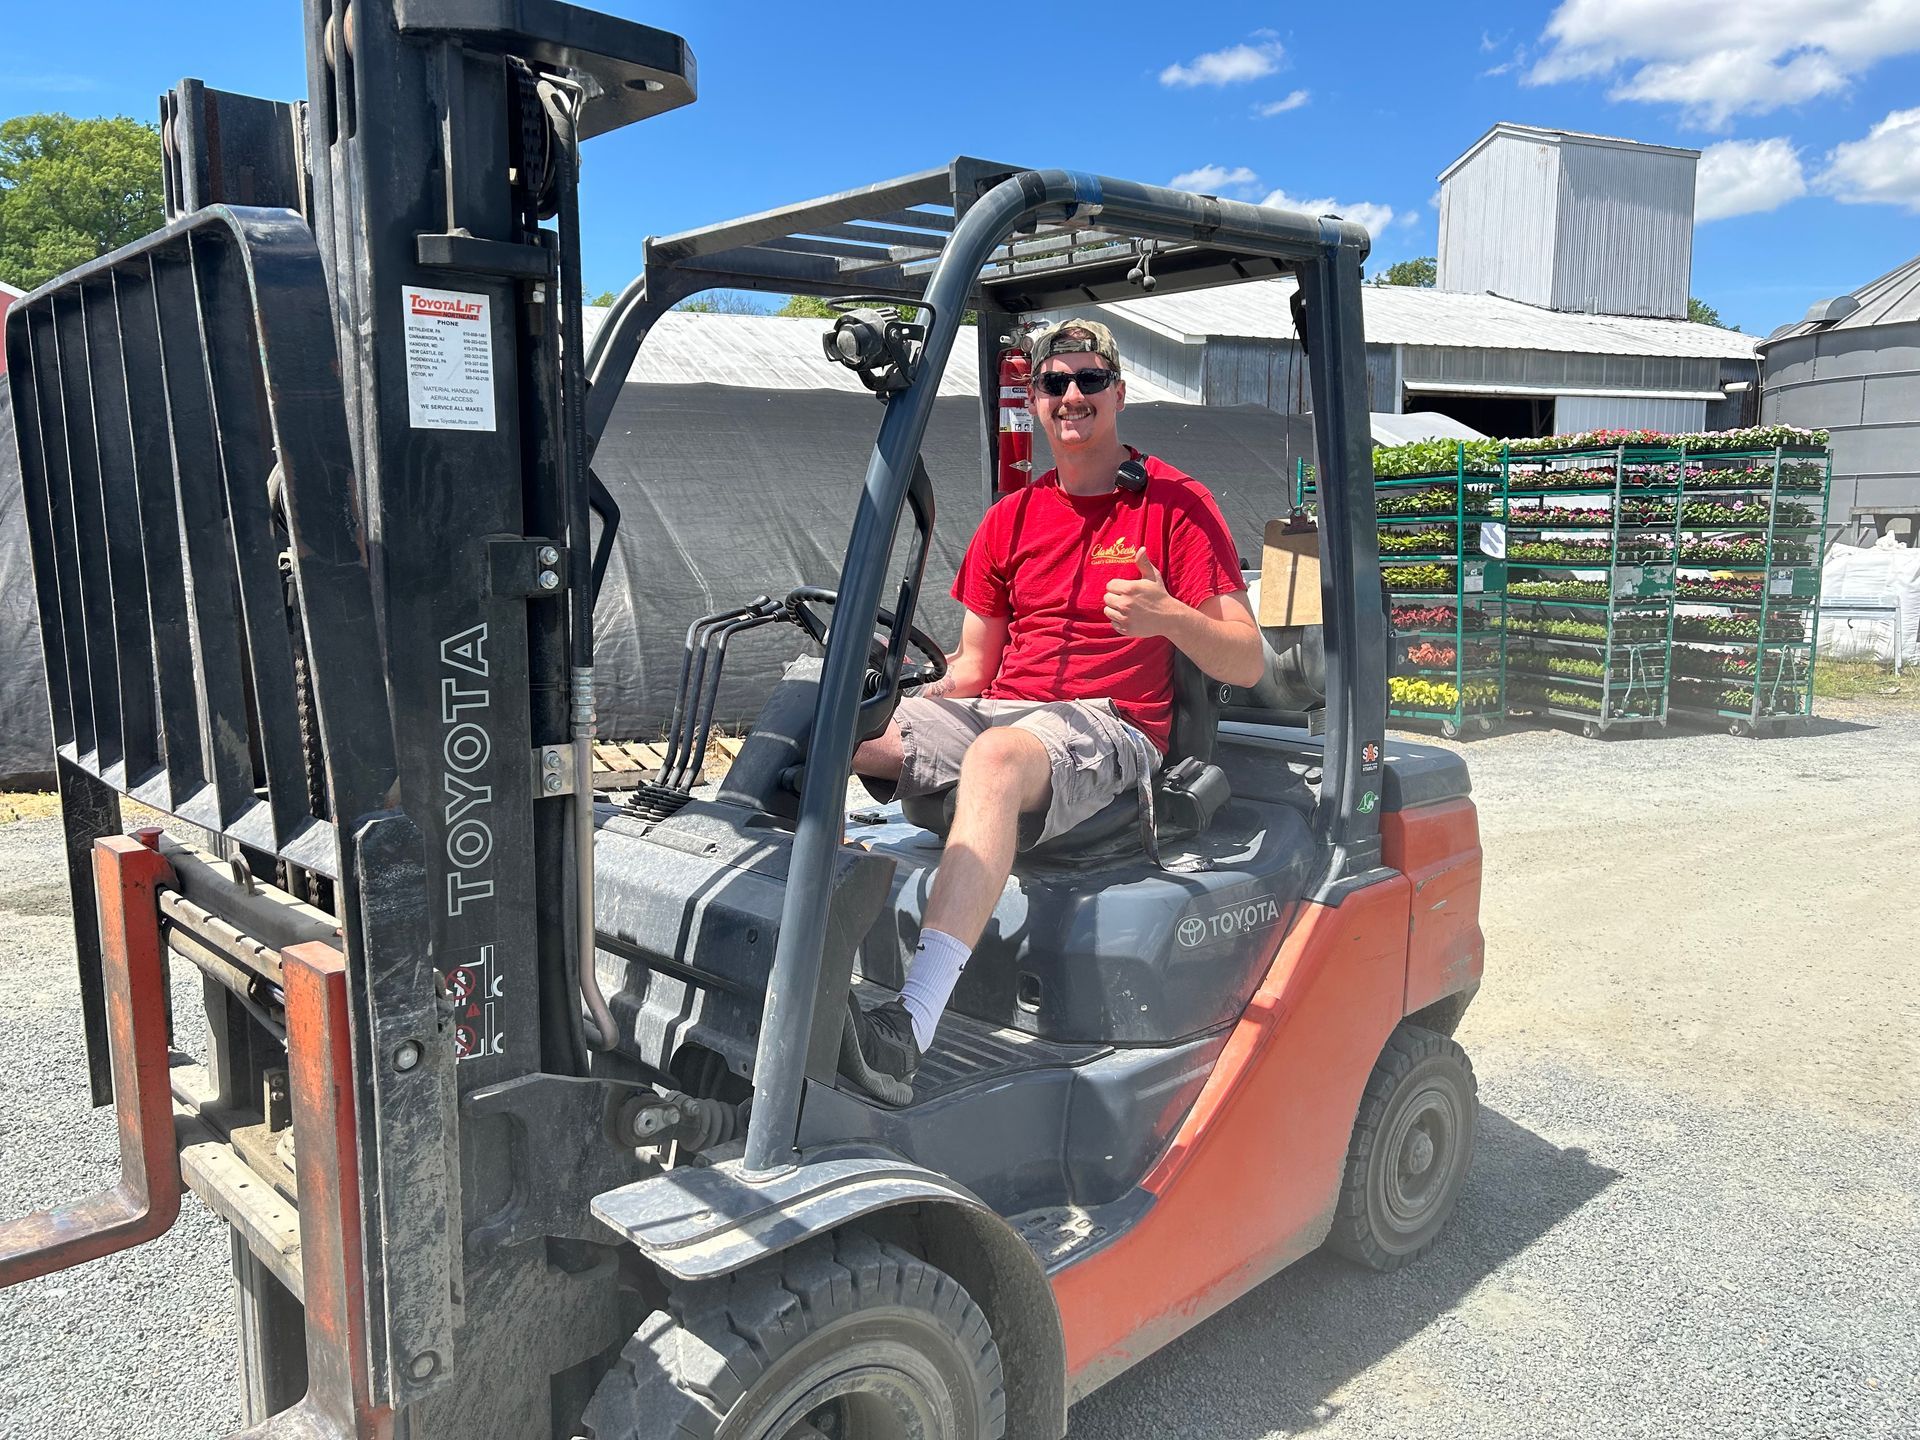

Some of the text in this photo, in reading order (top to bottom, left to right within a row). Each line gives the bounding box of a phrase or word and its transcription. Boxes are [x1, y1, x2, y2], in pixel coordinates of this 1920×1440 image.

[441, 622, 494, 917] TOYOTA
[1362, 743, 1379, 763] SAS
[1208, 900, 1279, 937] TOYOTA
